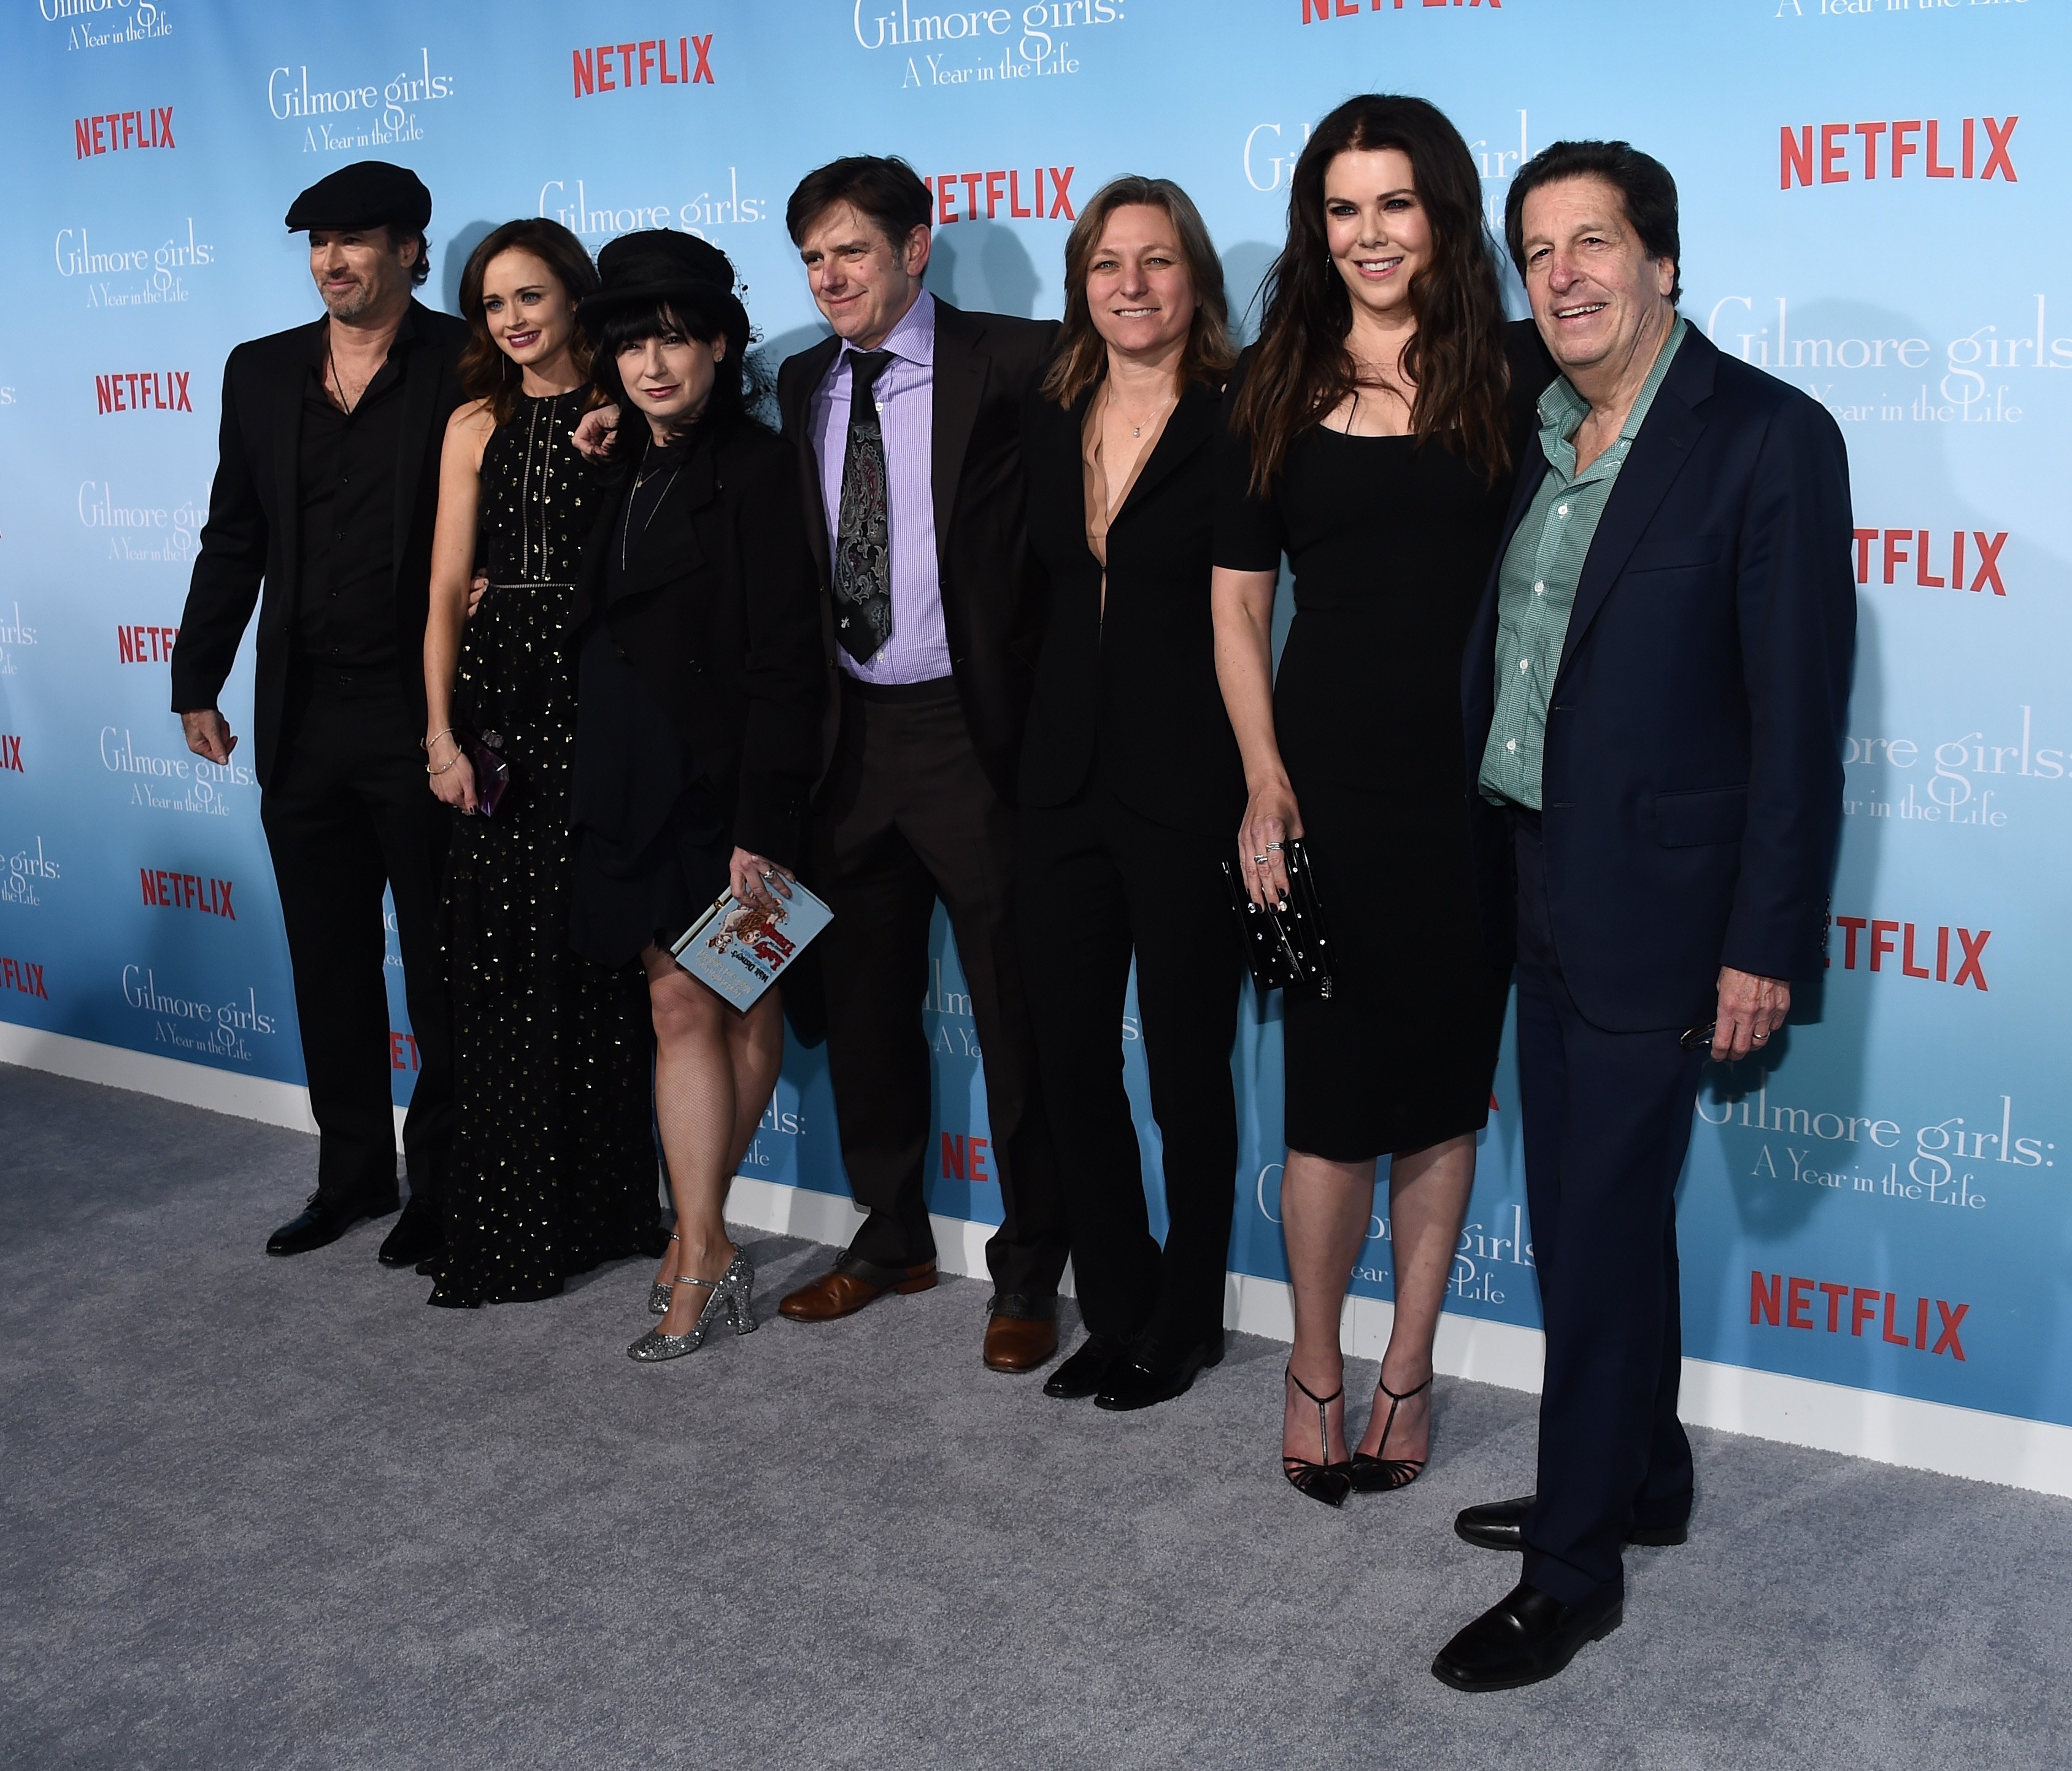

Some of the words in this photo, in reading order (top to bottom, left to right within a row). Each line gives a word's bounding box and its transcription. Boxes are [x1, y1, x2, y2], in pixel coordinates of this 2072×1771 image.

[69, 26, 79, 51] A
[81, 23, 110, 48] Year
[113, 25, 123, 44] in
[126, 16, 145, 42] the
[147, 10, 172, 37] Life
[572, 33, 715, 98] NETFLIX
[902, 57, 921, 88] A
[926, 53, 972, 85] Year
[977, 57, 993, 81] in
[998, 47, 1031, 79] the
[1035, 42, 1079, 75] Life
[268, 66, 377, 120] Gilmore
[383, 47, 454, 131] girls:
[74, 107, 175, 160] NETFLIX
[302, 126, 317, 153] A
[320, 124, 354, 150] Year
[357, 127, 368, 147] in
[372, 118, 393, 145] the
[393, 114, 424, 142] Life
[1781, 115, 2019, 190] NETFLIX
[539, 180, 670, 233] Gilmore
[680, 166, 766, 241] girls:
[55, 228, 148, 277] Gilmore
[153, 217, 215, 291] girls:
[87, 284, 98, 307] A
[100, 282, 128, 306] Year
[131, 286, 141, 305] in
[144, 280, 162, 304] the
[161, 277, 189, 303] Life
[1707, 296, 1930, 368] Gilmore
[95, 371, 192, 415] NETFLIX
[1881, 393, 1904, 421] in
[1911, 385, 1954, 422] the
[1960, 384, 2023, 422] Life
[79, 480, 168, 527] Gilmore
[109, 537, 120, 560] A
[122, 536, 148, 560] Year
[151, 542, 163, 561] in
[164, 537, 182, 561] the
[1852, 528, 2008, 596] TFLIX
[0, 601, 37, 645] irls:
[117, 625, 180, 664] NETF
[100, 726, 189, 779] Gilmore
[131, 783, 142, 805] A
[144, 784, 171, 809] Year
[173, 792, 183, 811] in
[185, 789, 203, 813] the
[203, 790, 230, 816] Life
[1869, 790, 1890, 818] in
[1899, 784, 1941, 822] the
[1948, 787, 2008, 828] Life
[10, 835, 61, 894] girls:
[17, 882, 40, 906] Life
[140, 868, 236, 920] NETFLIX
[752, 940, 785, 971] Lady
[752, 968, 769, 984] Walt
[1824, 916, 1992, 992] TFLIX
[0, 957, 48, 1001] FLIX
[123, 964, 212, 1022] Gilmore
[217, 987, 275, 1047] girls:
[156, 1021, 166, 1042] A
[167, 1022, 194, 1048] Year
[196, 1033, 207, 1051] in
[209, 1032, 225, 1056] the
[225, 1035, 252, 1061] Life
[936, 1025, 955, 1054] A
[758, 1086, 806, 1135] rls:
[742, 1139, 770, 1166] ife
[1908, 1095, 2055, 1187] girls:
[1750, 1144, 1779, 1179] A
[1787, 1148, 1847, 1187] Year
[1852, 1166, 1874, 1193] in
[1882, 1163, 1922, 1200] the
[1929, 1168, 1987, 1210] Life
[1350, 1266, 1388, 1283] ear
[1456, 1267, 1506, 1305] Life
[1749, 1270, 1970, 1362] NETFLIX
